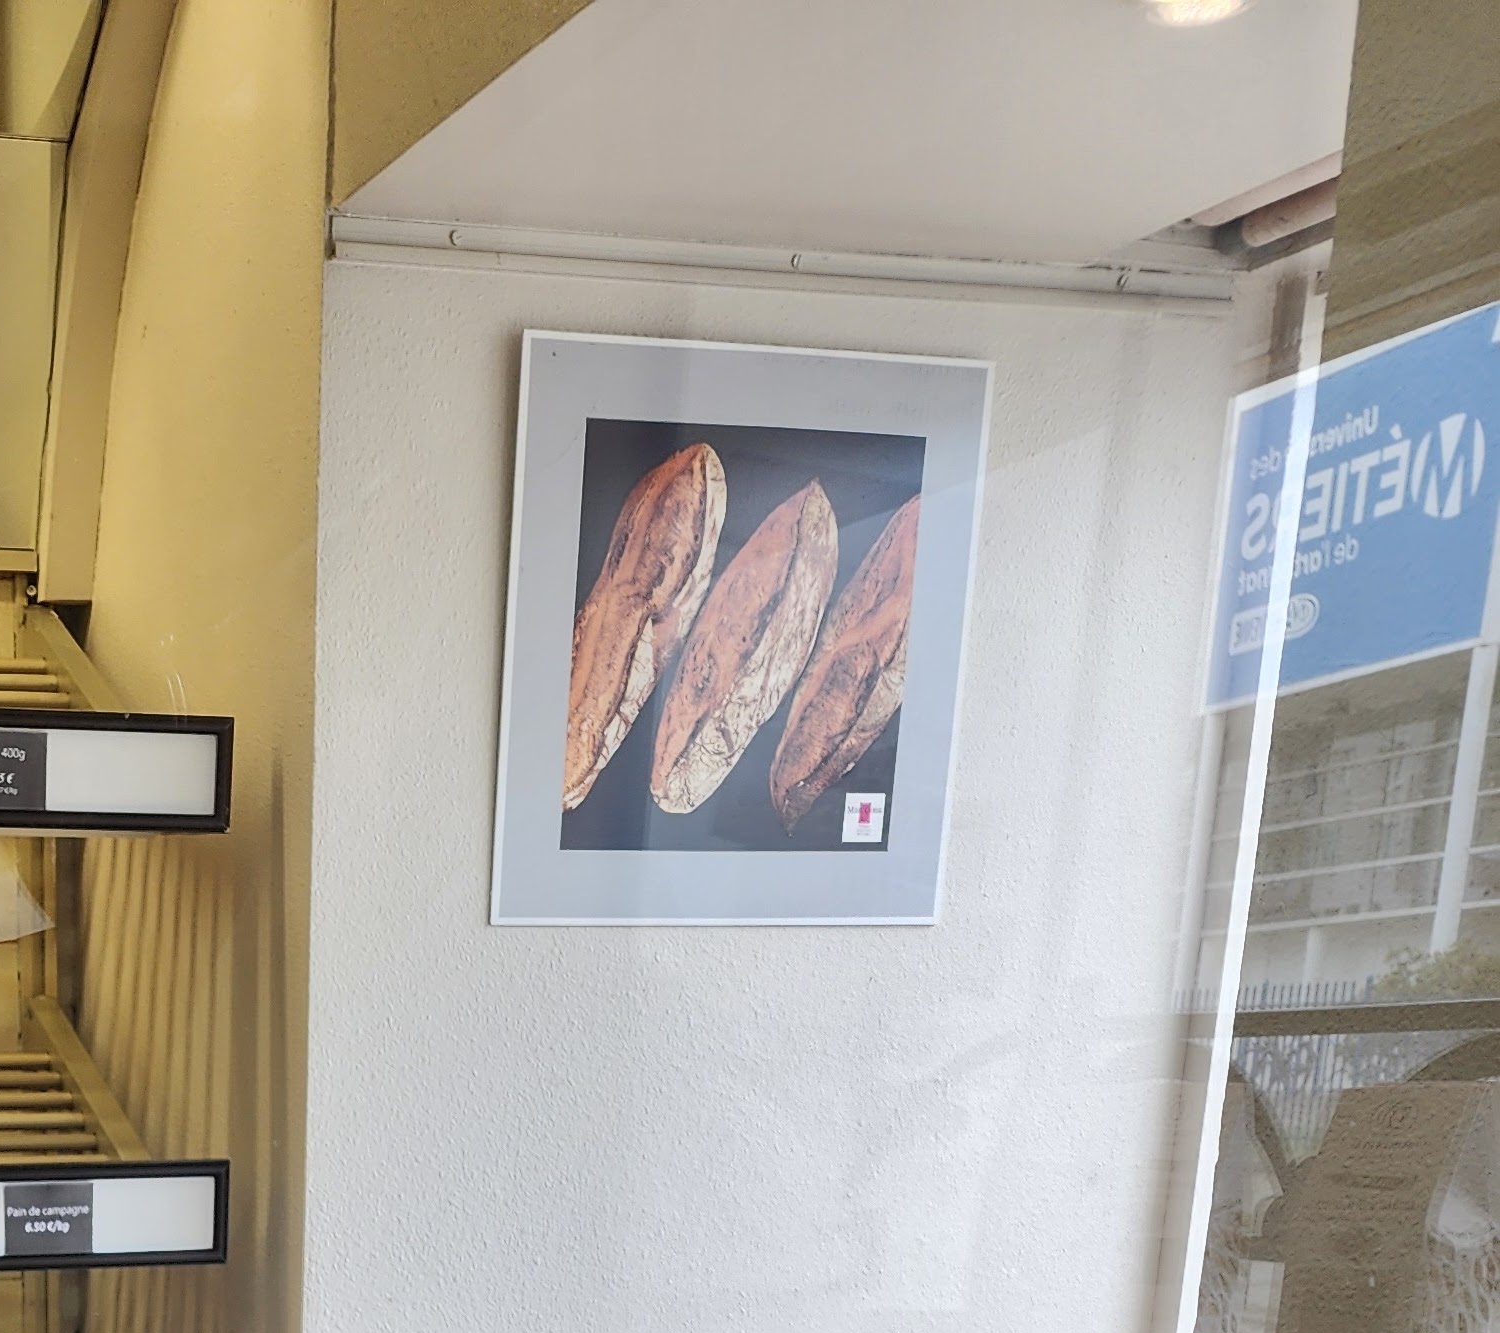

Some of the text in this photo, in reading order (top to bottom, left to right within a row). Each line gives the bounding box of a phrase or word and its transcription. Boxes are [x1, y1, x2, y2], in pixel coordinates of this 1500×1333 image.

[1, 747, 26, 762] 400g
[7, 1205, 90, 1217] Pain de campagne
